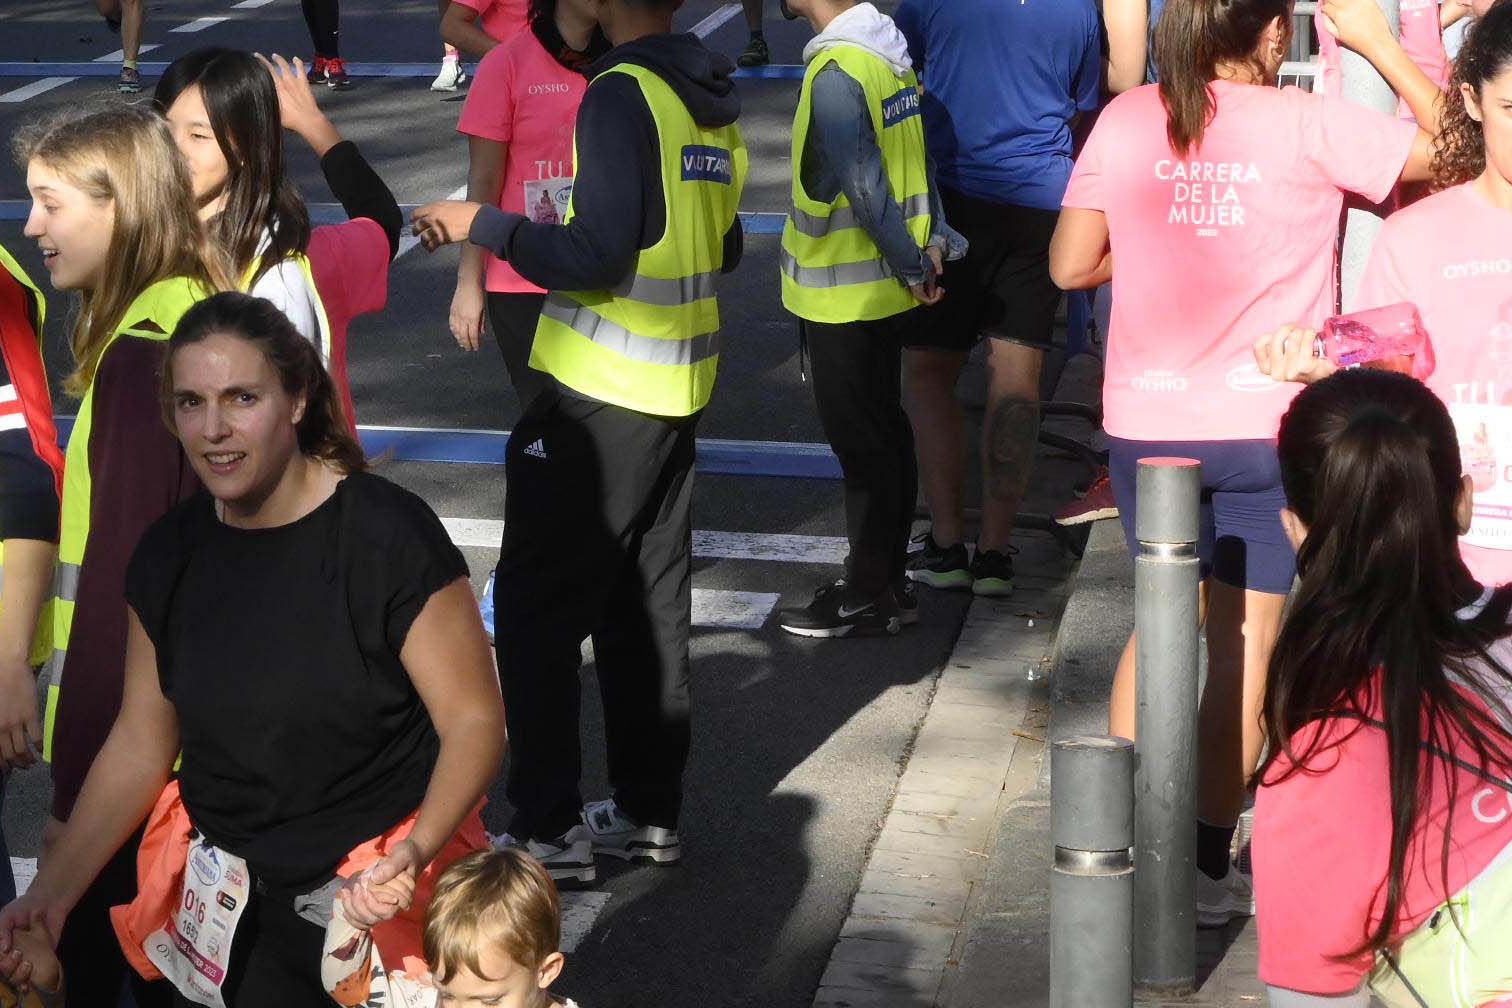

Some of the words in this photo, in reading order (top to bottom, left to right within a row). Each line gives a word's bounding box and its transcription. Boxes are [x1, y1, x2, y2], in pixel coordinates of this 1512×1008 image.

[527, 83, 570, 95] OYSHO
[535, 159, 564, 180] TU
[1154, 159, 1262, 184] CARRERA
[1174, 182, 1202, 204] DE
[1211, 183, 1241, 205] LA
[1167, 205, 1245, 226] MUJER
[1442, 258, 1512, 280] OYSHO
[523, 447, 547, 459] adidas
[184, 888, 206, 925] 016
